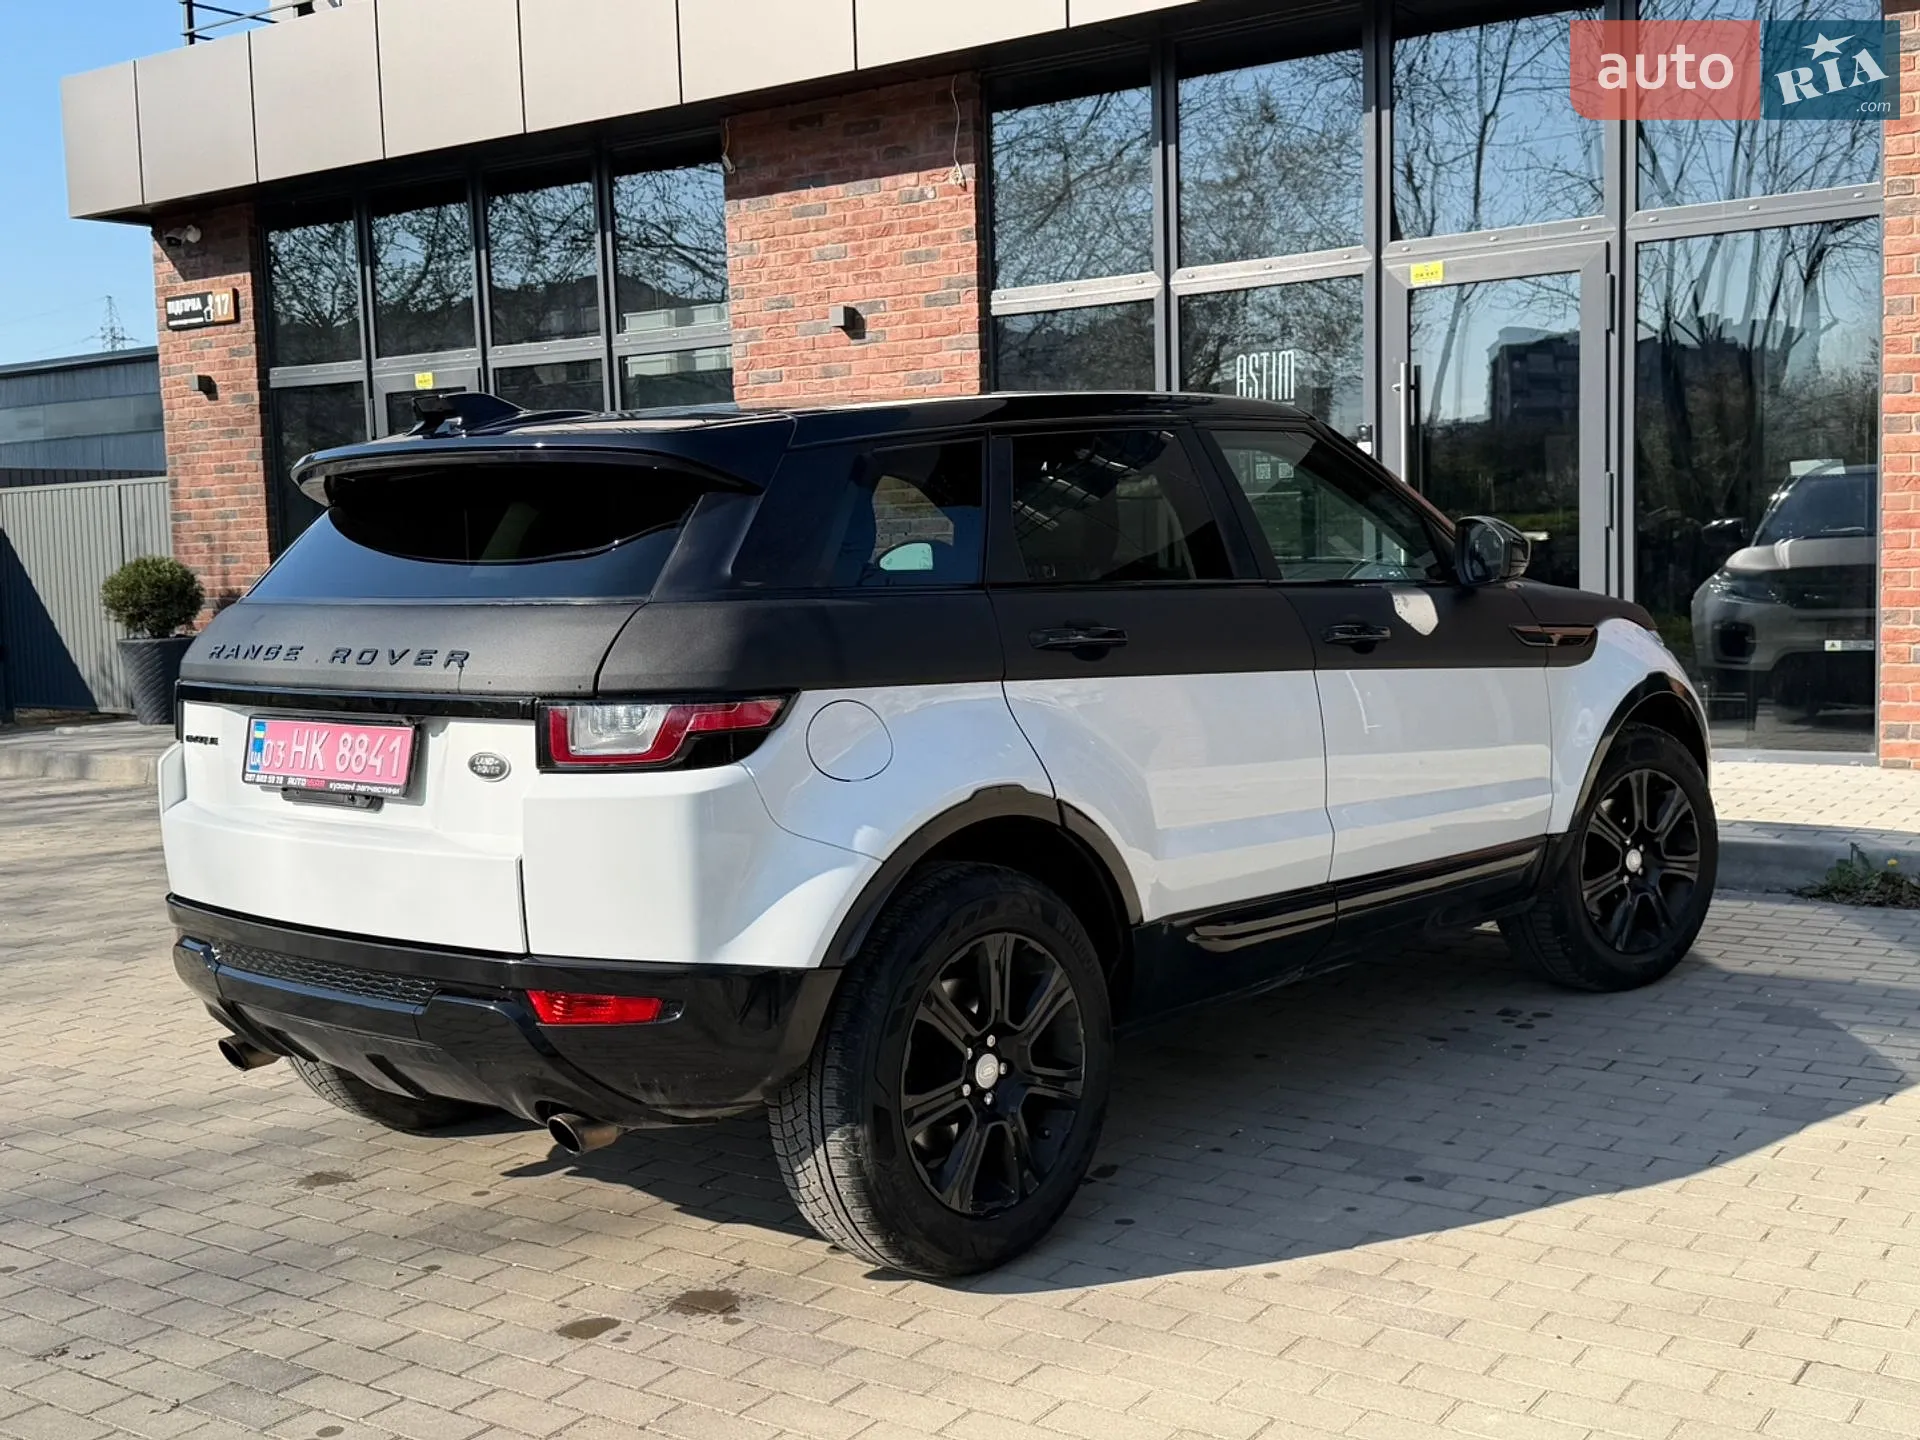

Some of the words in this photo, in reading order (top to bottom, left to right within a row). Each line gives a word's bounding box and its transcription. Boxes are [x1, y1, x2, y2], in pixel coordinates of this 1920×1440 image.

[214, 293, 230, 316] 17
[1236, 350, 1295, 401] ASTIM
[208, 644, 304, 662] RANGE
[328, 647, 470, 669] ROVER
[263, 739, 286, 769] 03
[289, 728, 331, 771] HK
[335, 732, 403, 778] 8841
